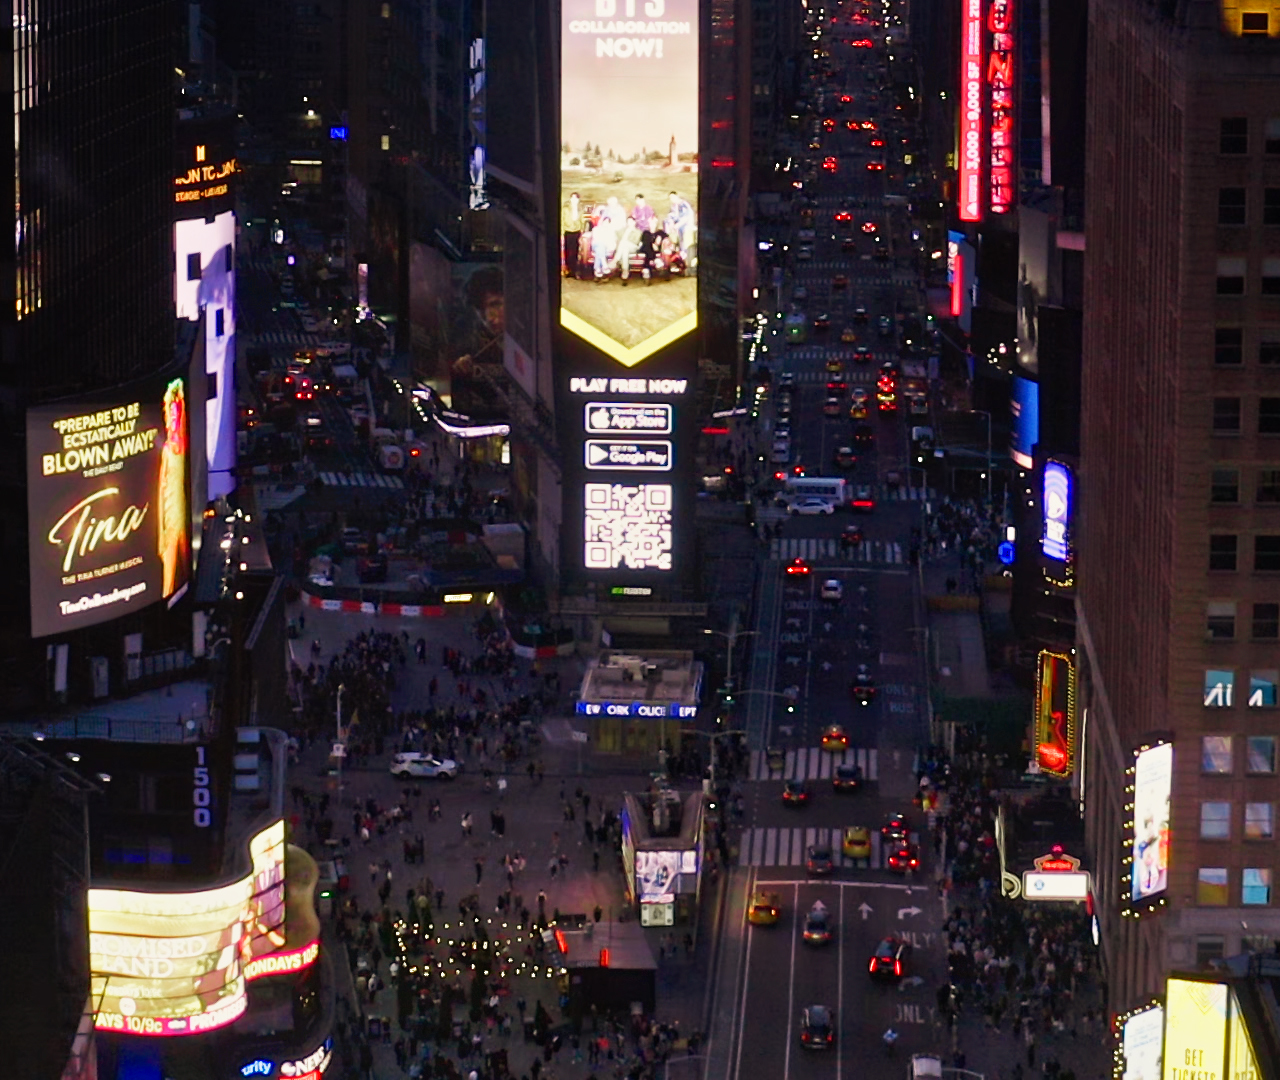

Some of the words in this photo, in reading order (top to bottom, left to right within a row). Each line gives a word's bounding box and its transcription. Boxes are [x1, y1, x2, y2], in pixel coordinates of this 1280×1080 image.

[568, 21, 691, 34] COLLABORATION
[595, 37, 664, 59] NOW!
[570, 377, 609, 392] PLAY
[610, 378, 647, 394] FREE
[649, 380, 688, 394] NOW
[111, 407, 126, 423] TO
[127, 402, 140, 419] BE
[611, 415, 636, 428] App
[636, 415, 666, 428] Store
[63, 419, 136, 450] ECSTATICALLY
[42, 444, 110, 477] BLOWN
[610, 451, 646, 465] Google
[646, 450, 666, 465] Play
[47, 486, 150, 572] Tina
[576, 701, 601, 715] NEW
[602, 701, 630, 716] YORK
[632, 702, 666, 716] POLICE
[670, 702, 697, 717] DEPT
[193, 746, 212, 828] 1500
[102, 955, 174, 978] LAND
[243, 953, 301, 980] MONDAYS
[93, 1012, 124, 1027] AYS
[125, 1017, 163, 1033] 10/9c
[1184, 1048, 1204, 1067] GET
